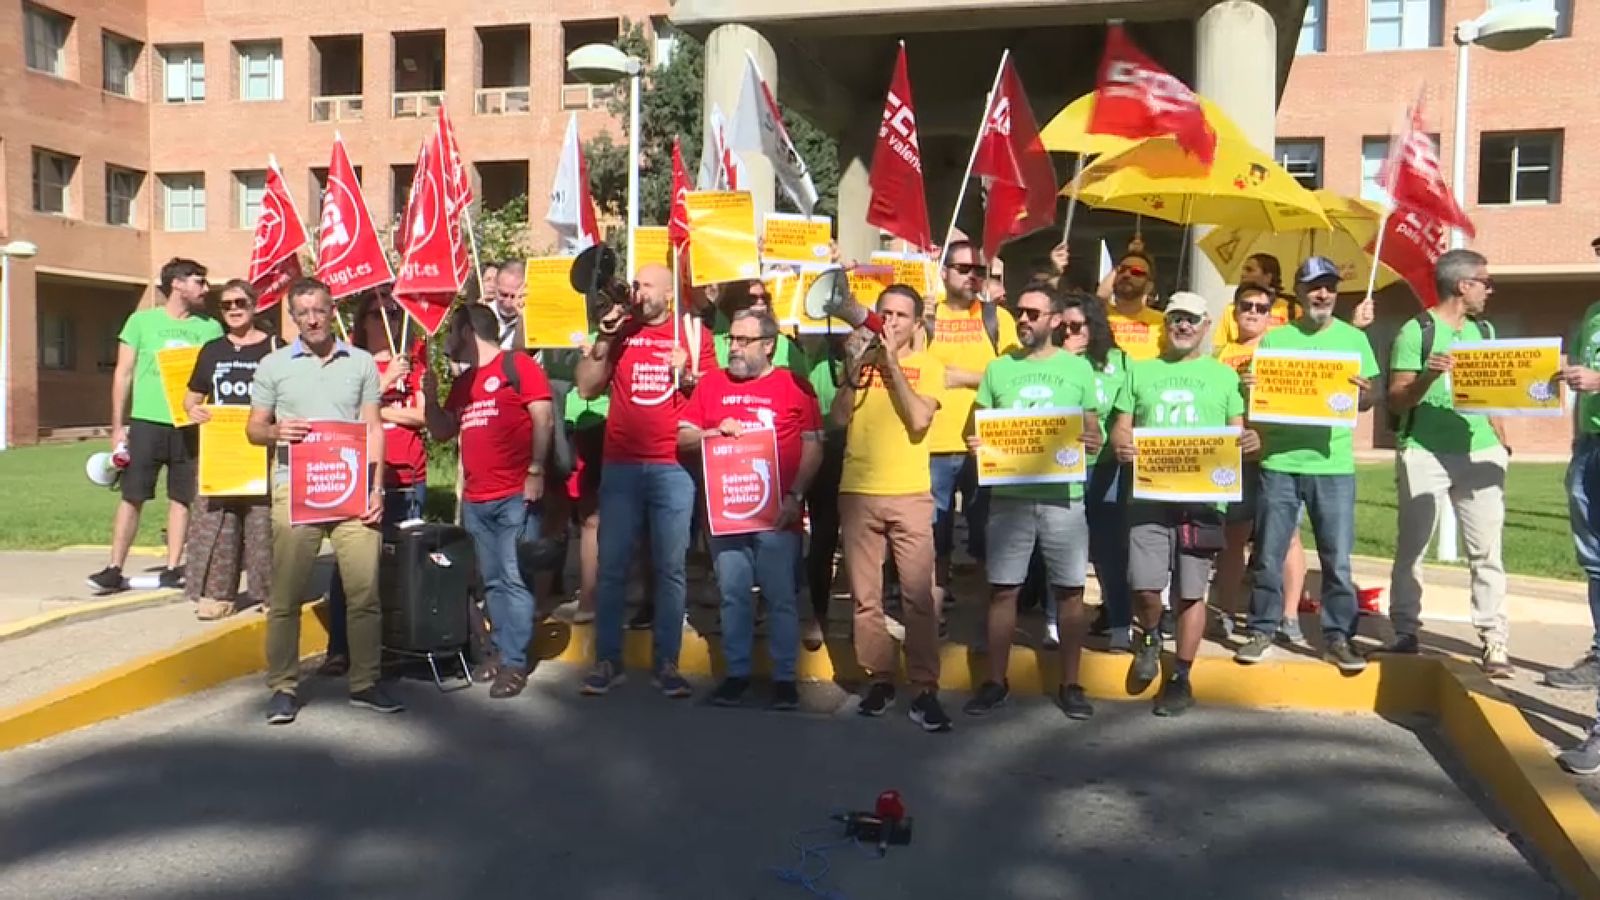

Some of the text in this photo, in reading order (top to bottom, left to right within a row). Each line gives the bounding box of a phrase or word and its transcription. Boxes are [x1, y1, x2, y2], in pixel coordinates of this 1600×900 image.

[1472, 349, 1543, 360] L'APLICACIÓ
[1256, 359, 1276, 368] PER
[1277, 360, 1344, 371] L'APLICACIÓ
[1517, 360, 1532, 368] DE
[1321, 372, 1334, 380] DE
[1453, 370, 1498, 378] L'ACORD
[1302, 379, 1315, 387] DE
[1453, 378, 1517, 387] PLANTILLES
[979, 416, 1067, 431] PER L'APLICACIÓ
[981, 427, 1060, 439] IMMEDIATA DE
[1028, 436, 1041, 446] DE
[1137, 437, 1225, 448] PER L'APLICACIÓ
[1202, 447, 1216, 455] DE
[1138, 456, 1198, 464] L'ACORD DE
[306, 461, 347, 472] Salvem
[1137, 464, 1201, 473] PLANTILLES
[306, 471, 347, 482] l'escola
[722, 473, 759, 484] Salvem
[306, 481, 346, 496] pública
[722, 483, 760, 494] l'escola
[723, 493, 760, 506] pública
